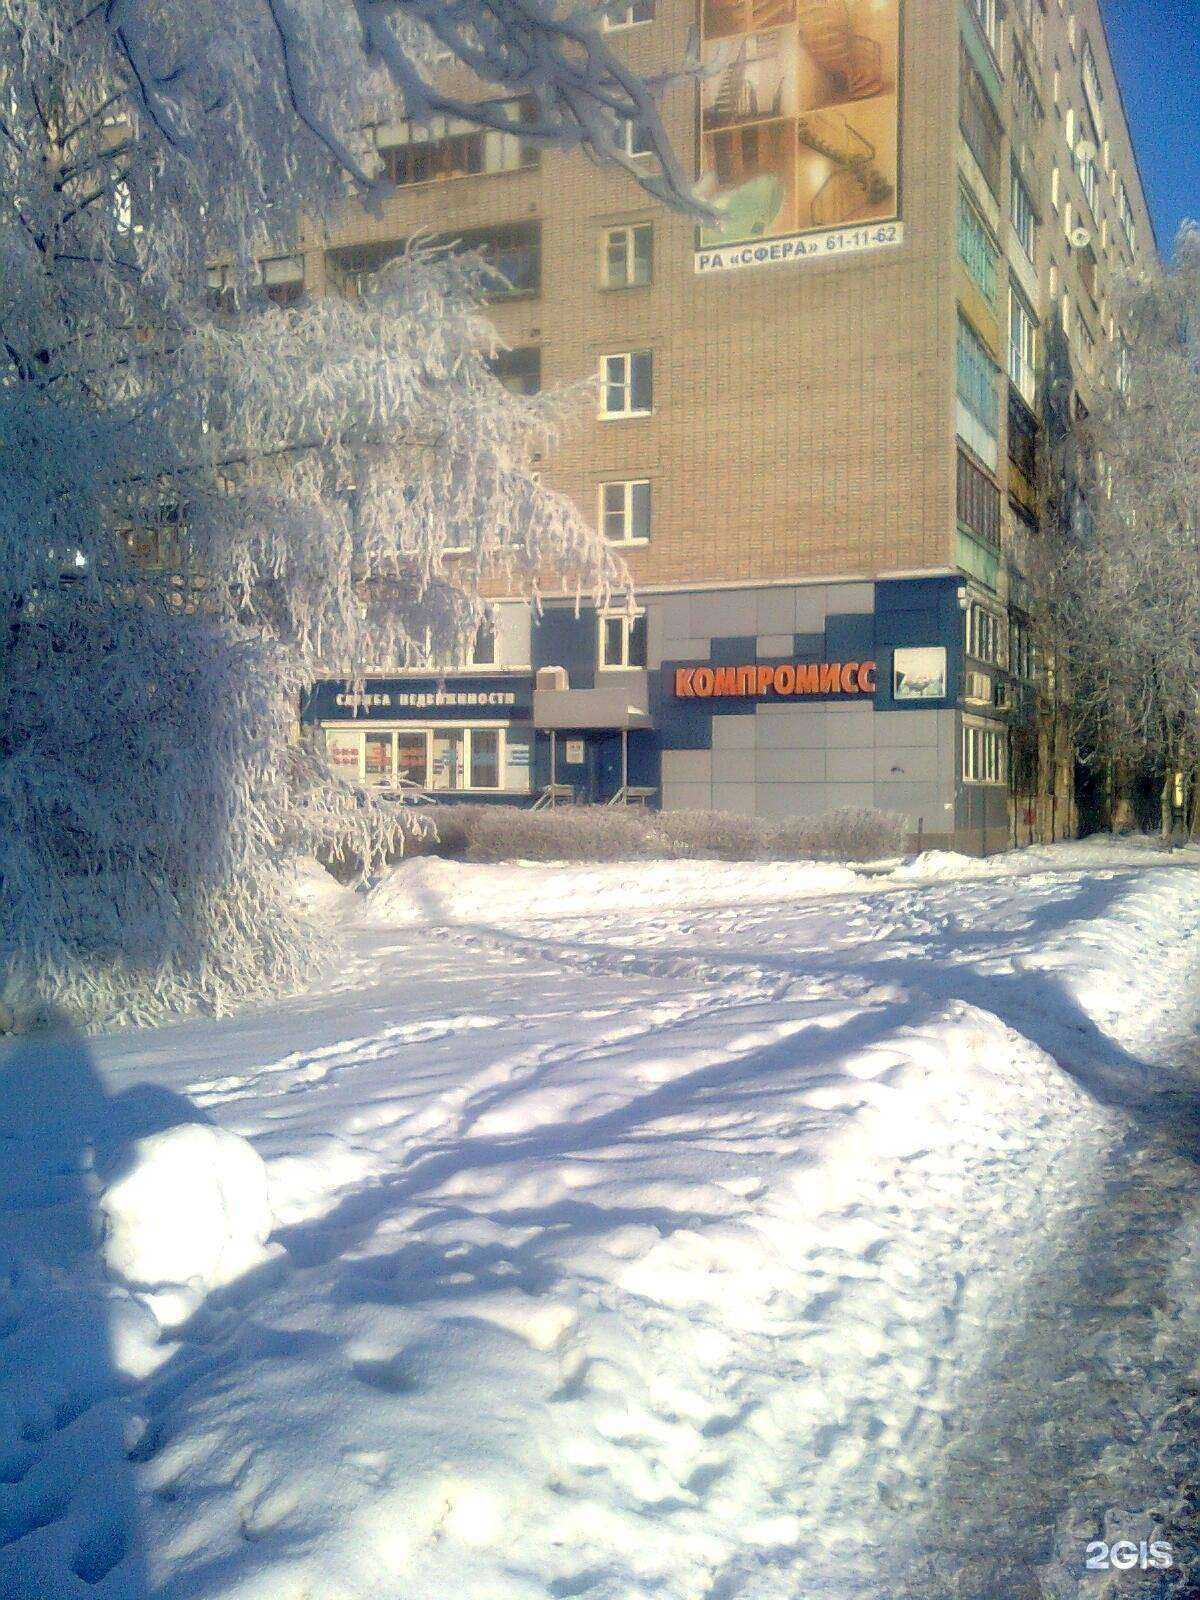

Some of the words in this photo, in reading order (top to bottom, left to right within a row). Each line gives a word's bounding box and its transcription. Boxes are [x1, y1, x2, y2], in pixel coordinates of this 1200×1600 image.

[699, 253, 724, 270] РА
[730, 240, 818, 264] «СФЕРА»
[826, 226, 897, 250] 61-11-62
[675, 660, 877, 697] КОМПРОМИСС
